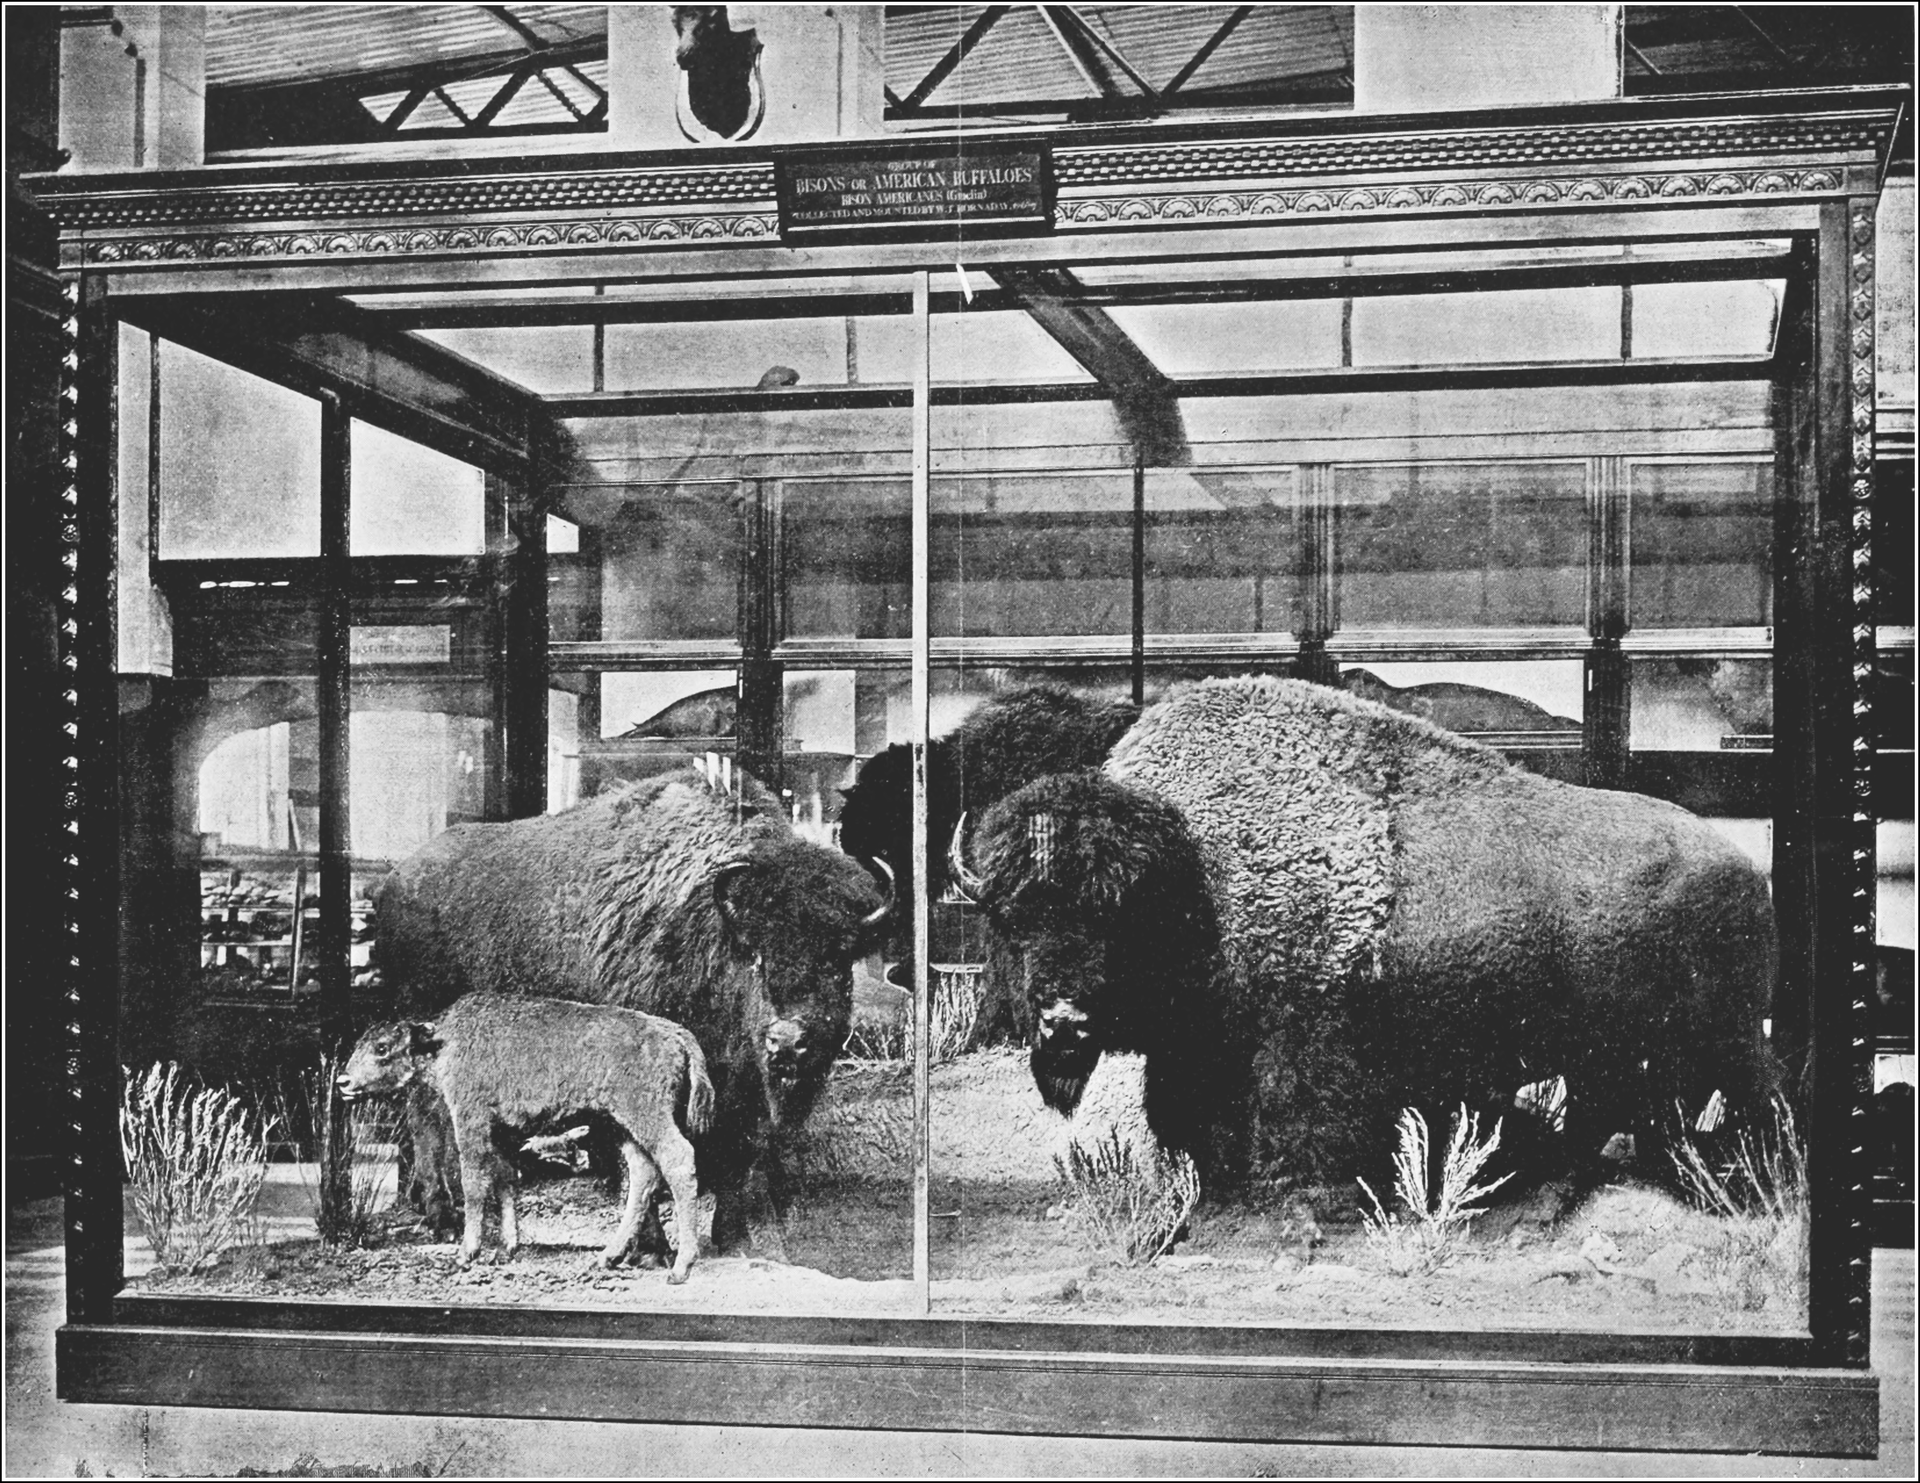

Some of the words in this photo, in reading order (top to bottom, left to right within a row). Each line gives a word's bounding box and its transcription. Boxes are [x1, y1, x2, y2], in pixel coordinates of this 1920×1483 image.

[796, 176, 846, 194] BISONS
[851, 178, 867, 190] OR
[875, 171, 946, 190] AMERICAN
[953, 167, 1033, 186] BUFFALOES
[841, 193, 872, 206] BISON
[852, 208, 872, 217] AND
